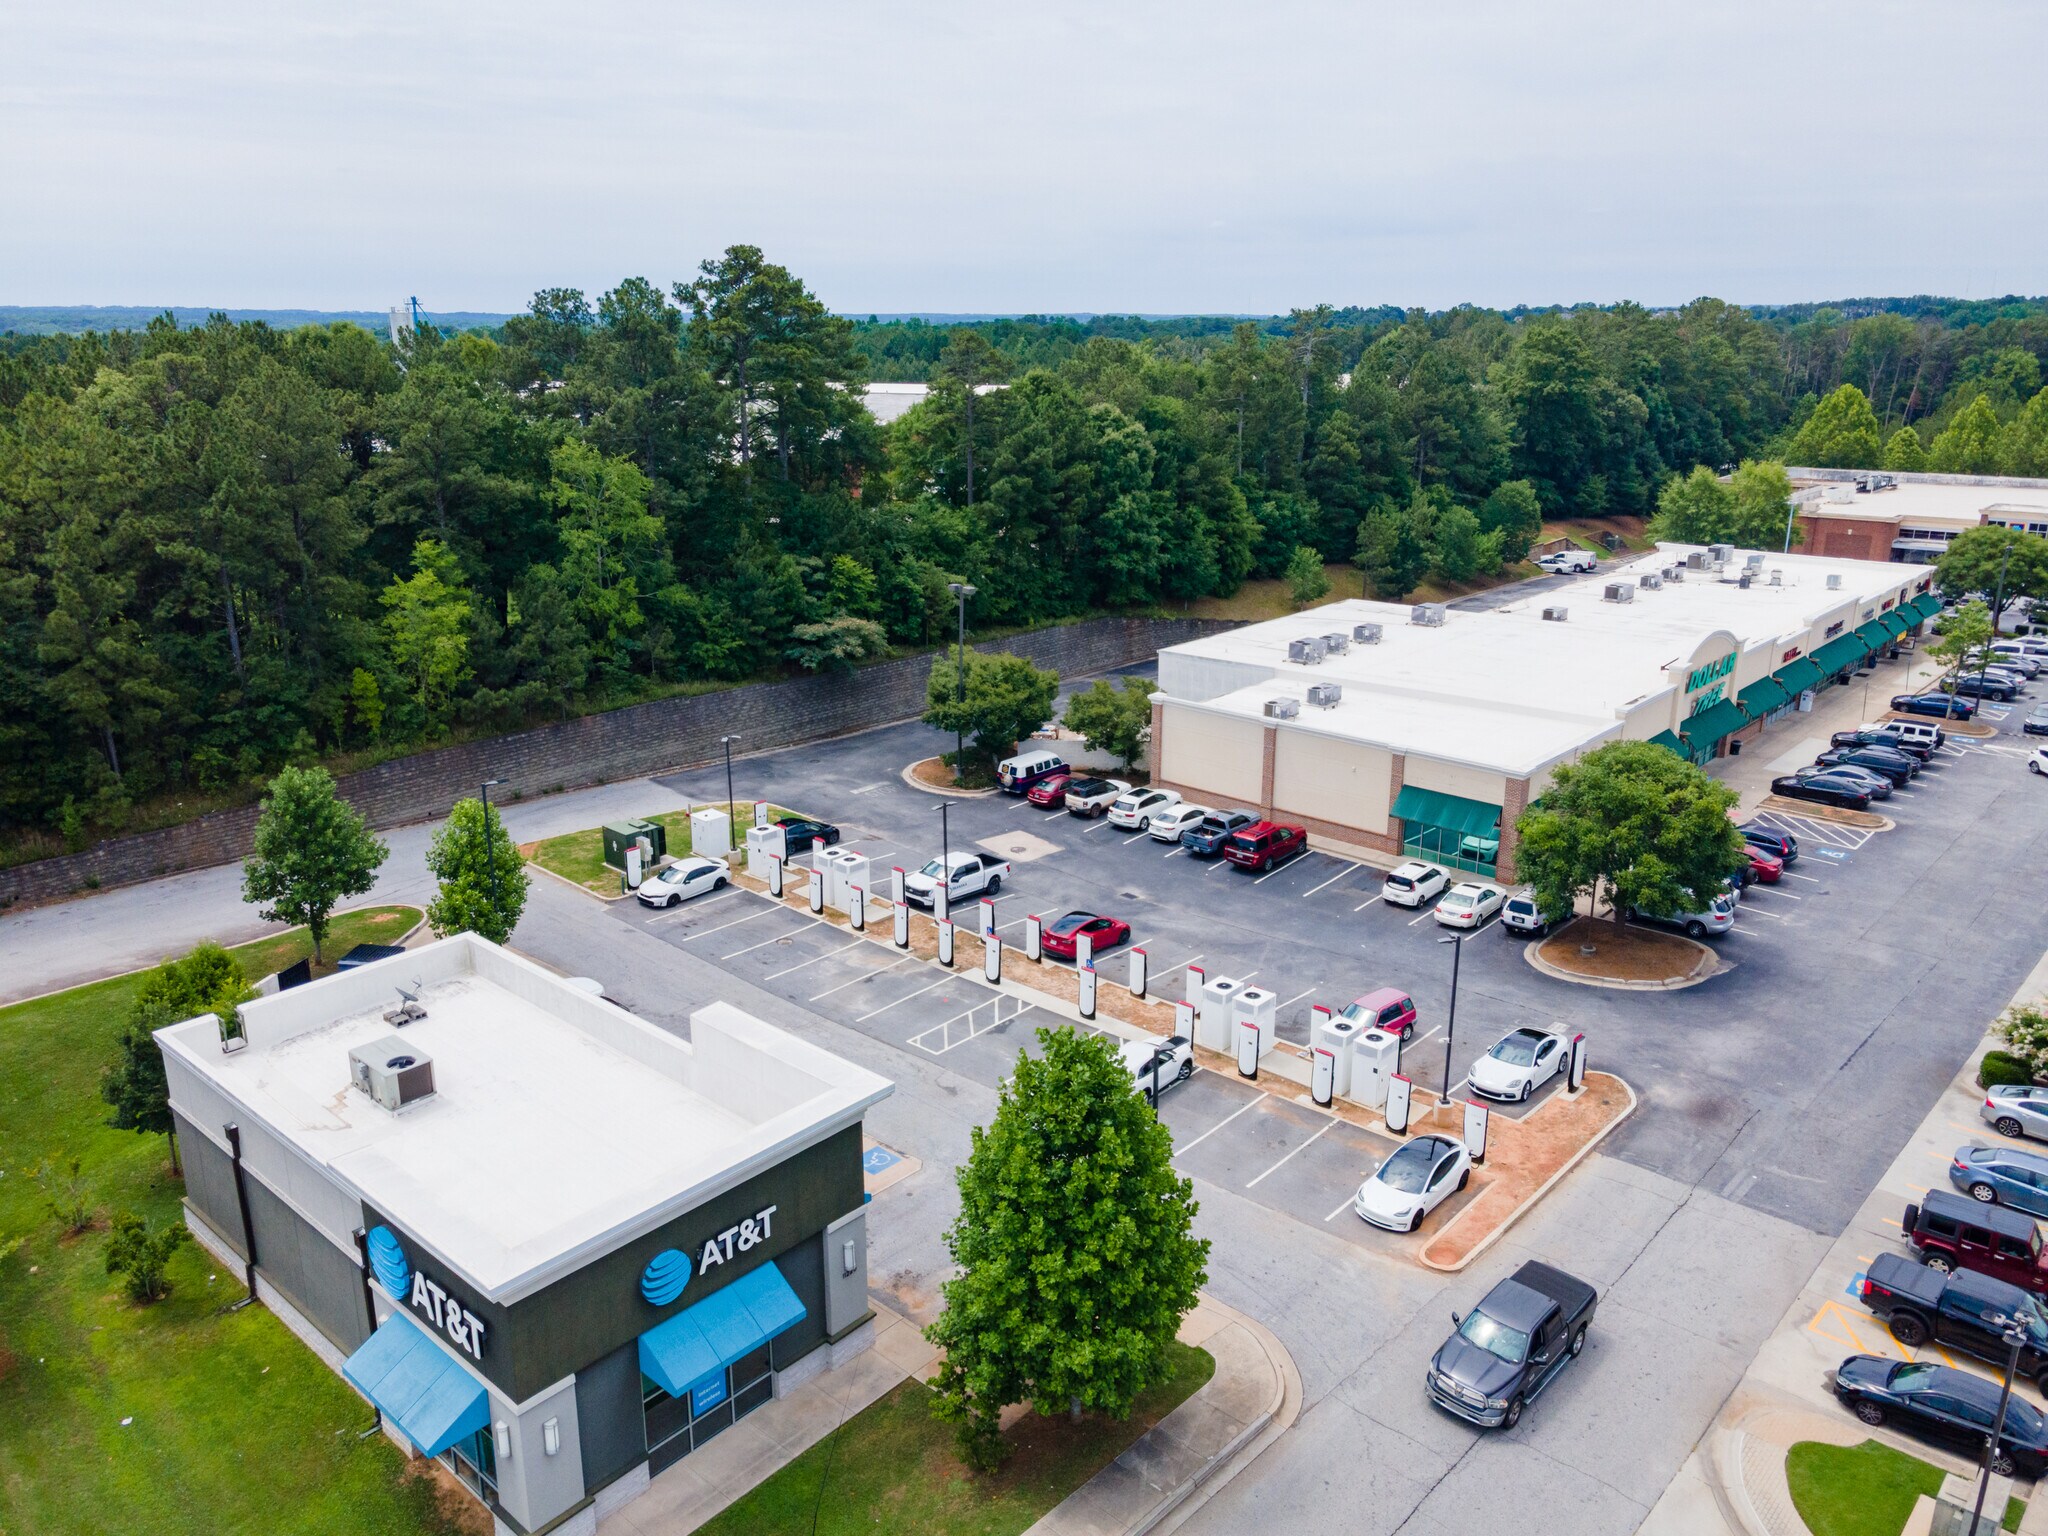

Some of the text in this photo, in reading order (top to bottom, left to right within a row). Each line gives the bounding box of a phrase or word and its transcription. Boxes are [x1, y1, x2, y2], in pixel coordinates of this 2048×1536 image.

[1686, 651, 1738, 694] DOLLAR
[1692, 681, 1726, 717] TREE
[699, 1204, 777, 1276] AT&T
[412, 1270, 485, 1360] AT&T
